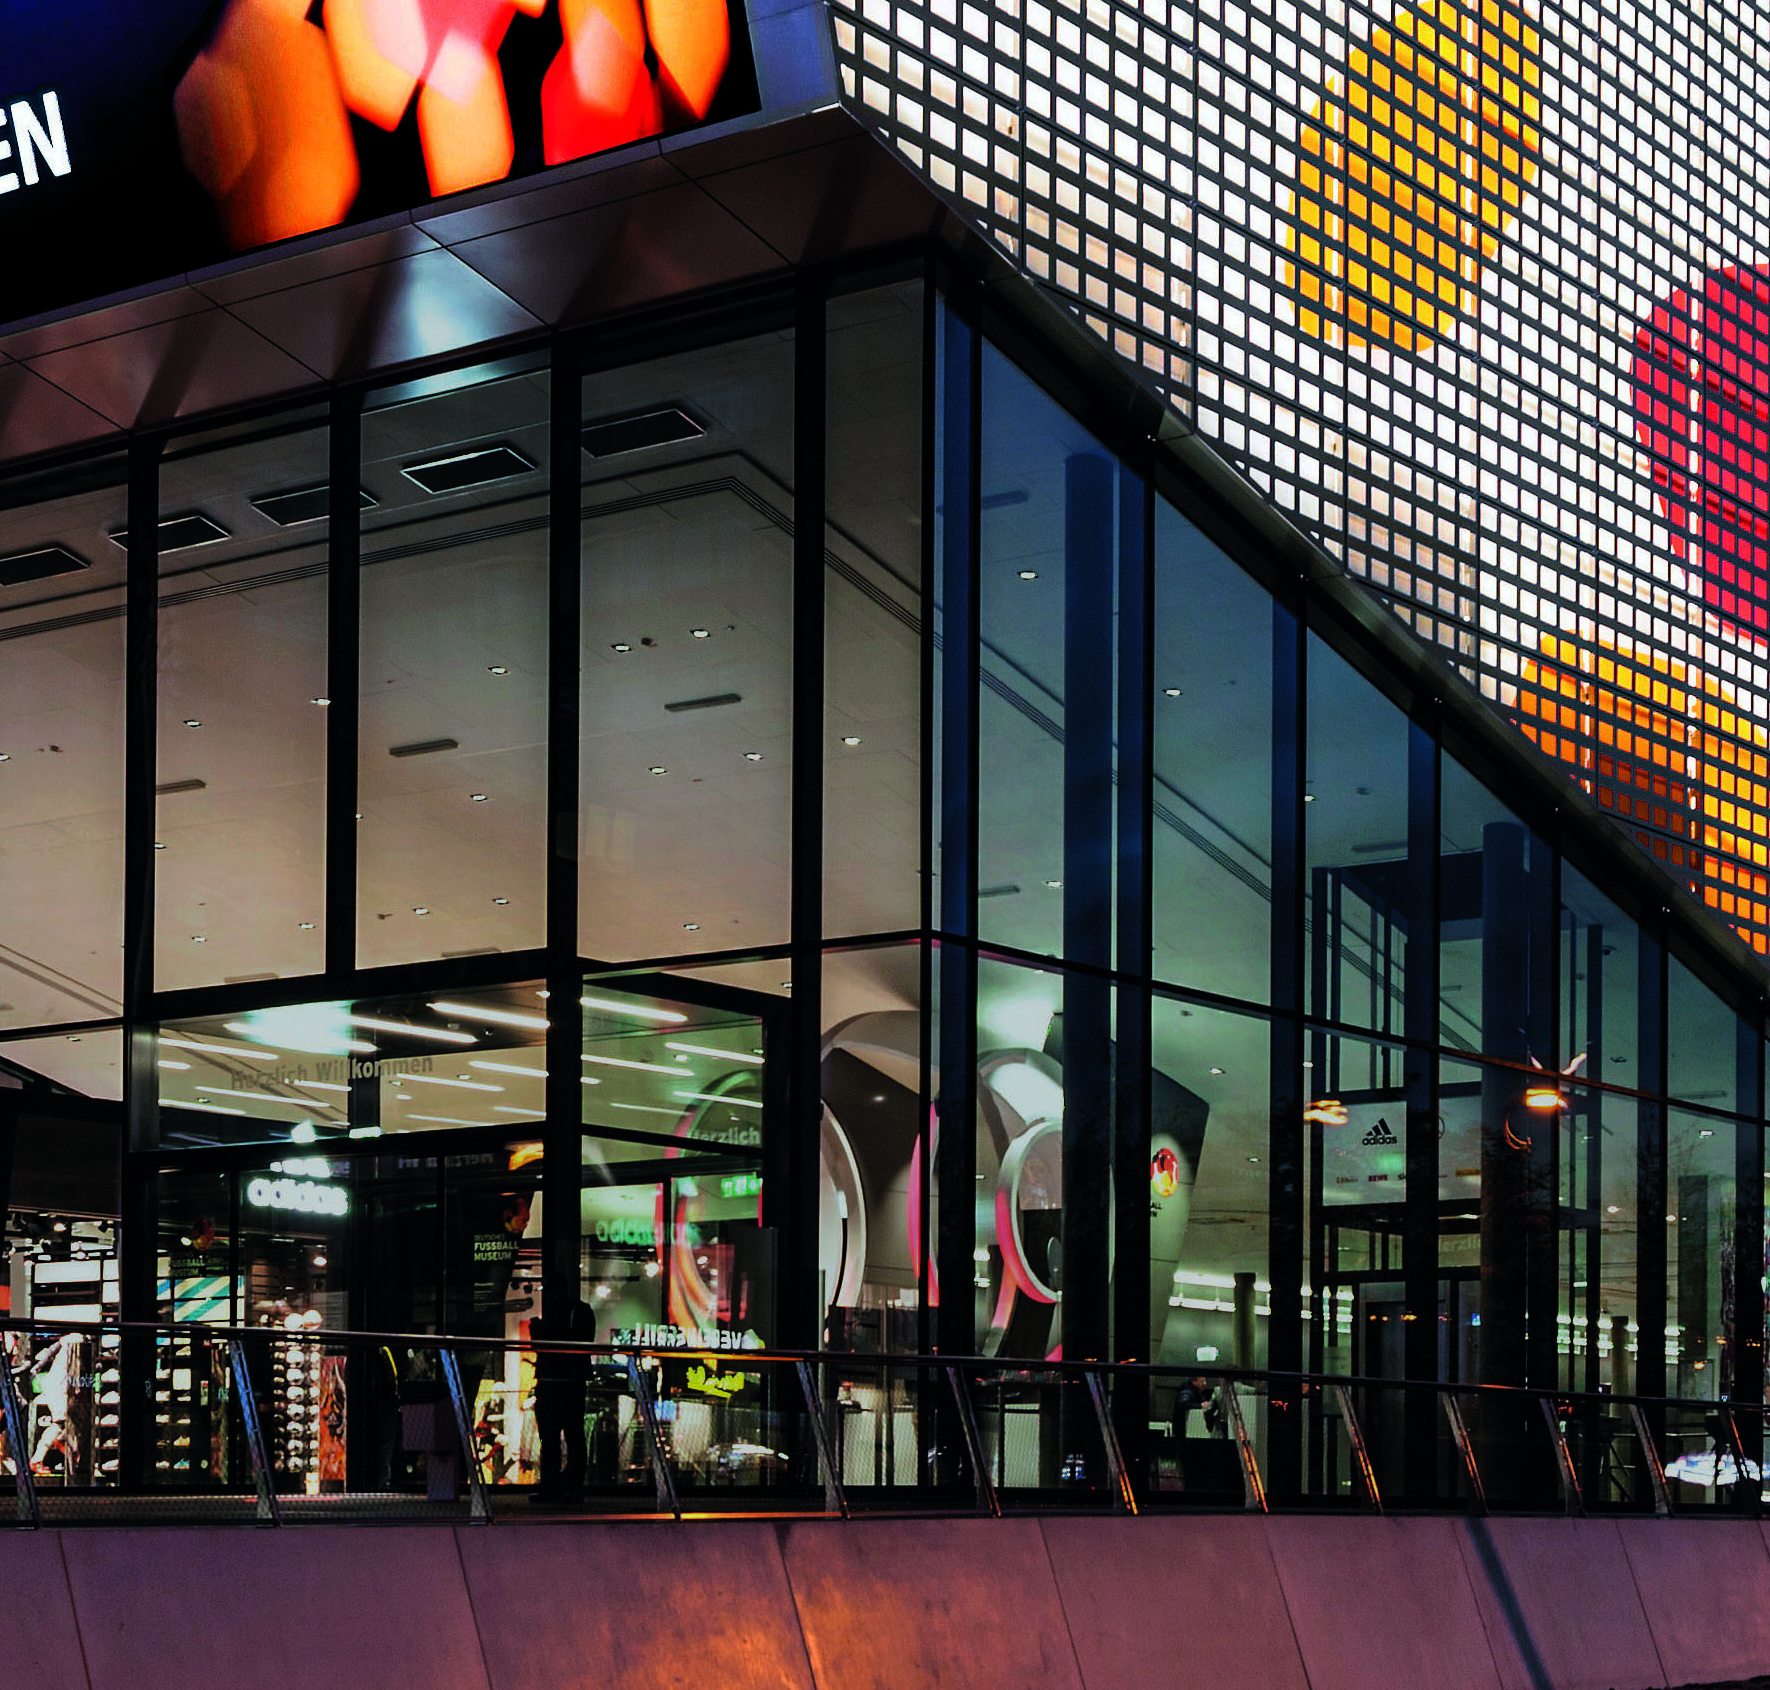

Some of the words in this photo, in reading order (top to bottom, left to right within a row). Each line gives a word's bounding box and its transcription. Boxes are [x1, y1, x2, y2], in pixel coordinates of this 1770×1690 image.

[231, 1063, 308, 1090] Herzlich
[316, 1057, 434, 1081] Willkommen
[1362, 1135, 1398, 1146] adidas
[247, 1177, 349, 1216] adidas
[474, 1241, 519, 1251] FUSSBALL
[474, 1251, 512, 1261] MUSEUM
